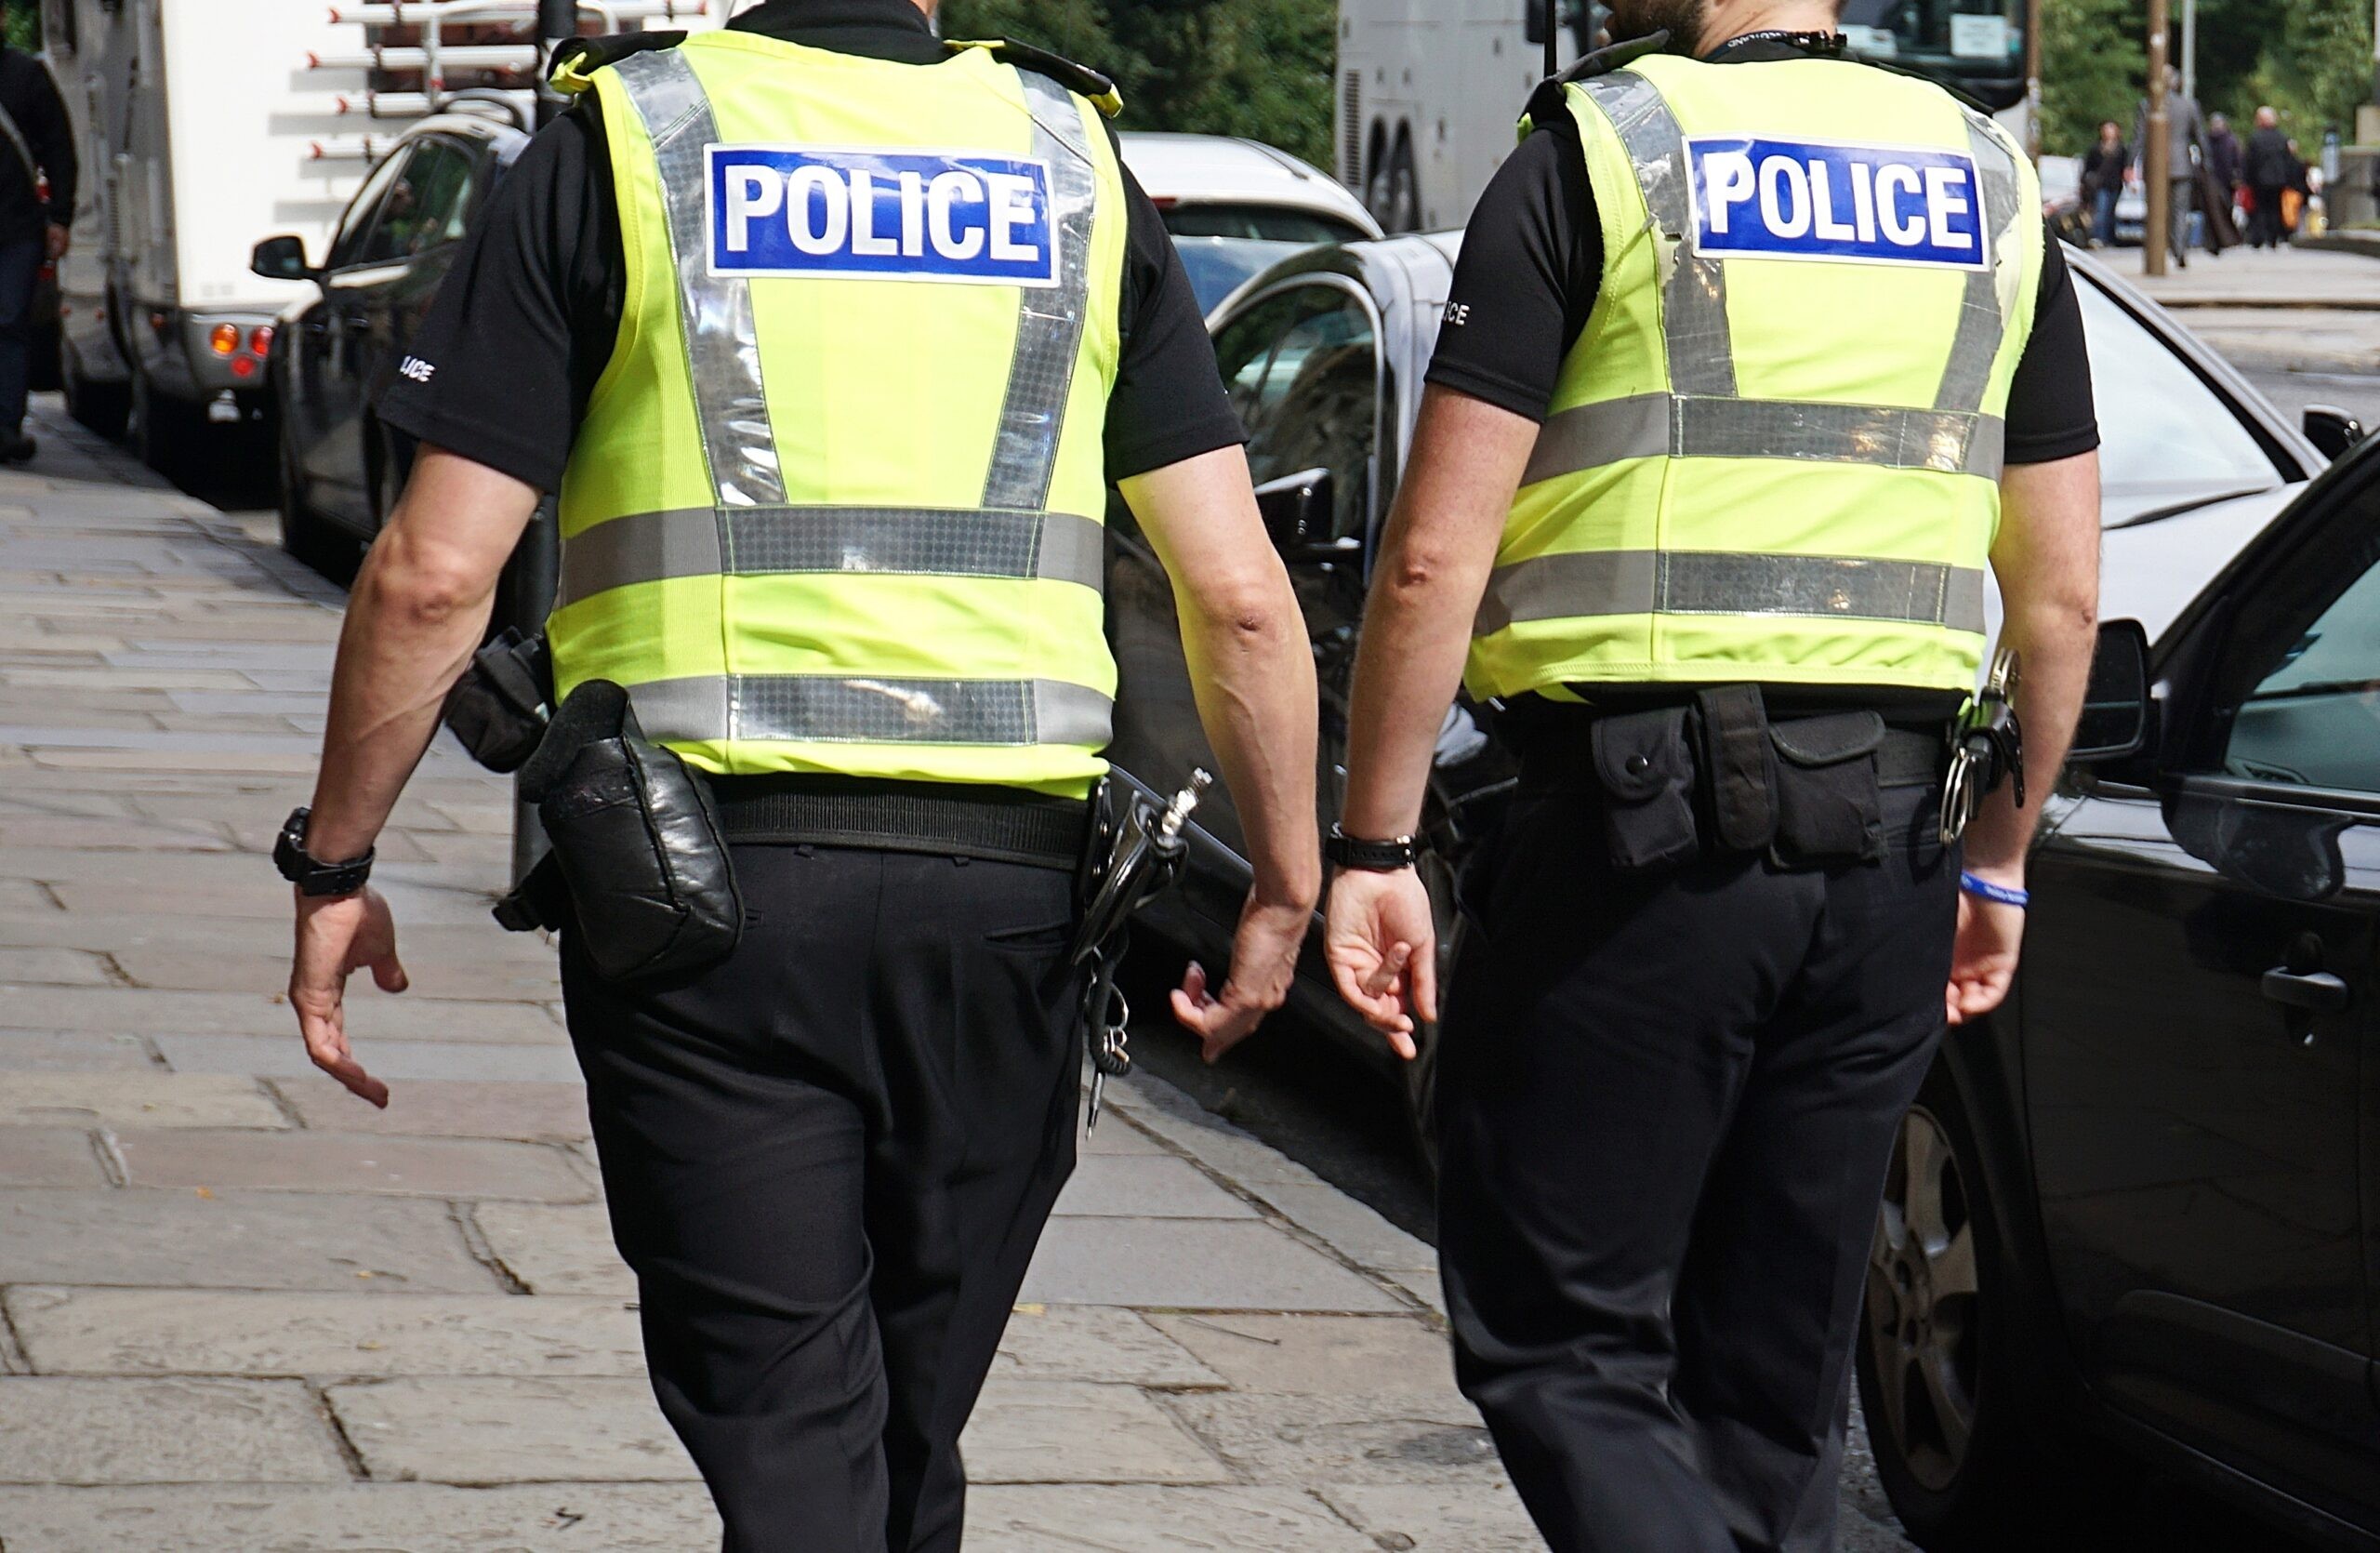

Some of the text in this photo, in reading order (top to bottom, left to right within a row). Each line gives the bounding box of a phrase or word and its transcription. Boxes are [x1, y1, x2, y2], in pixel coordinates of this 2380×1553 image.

[725, 165, 1038, 261] POLICE
[1703, 152, 1973, 248] POLICE
[400, 355, 435, 382] LICE
